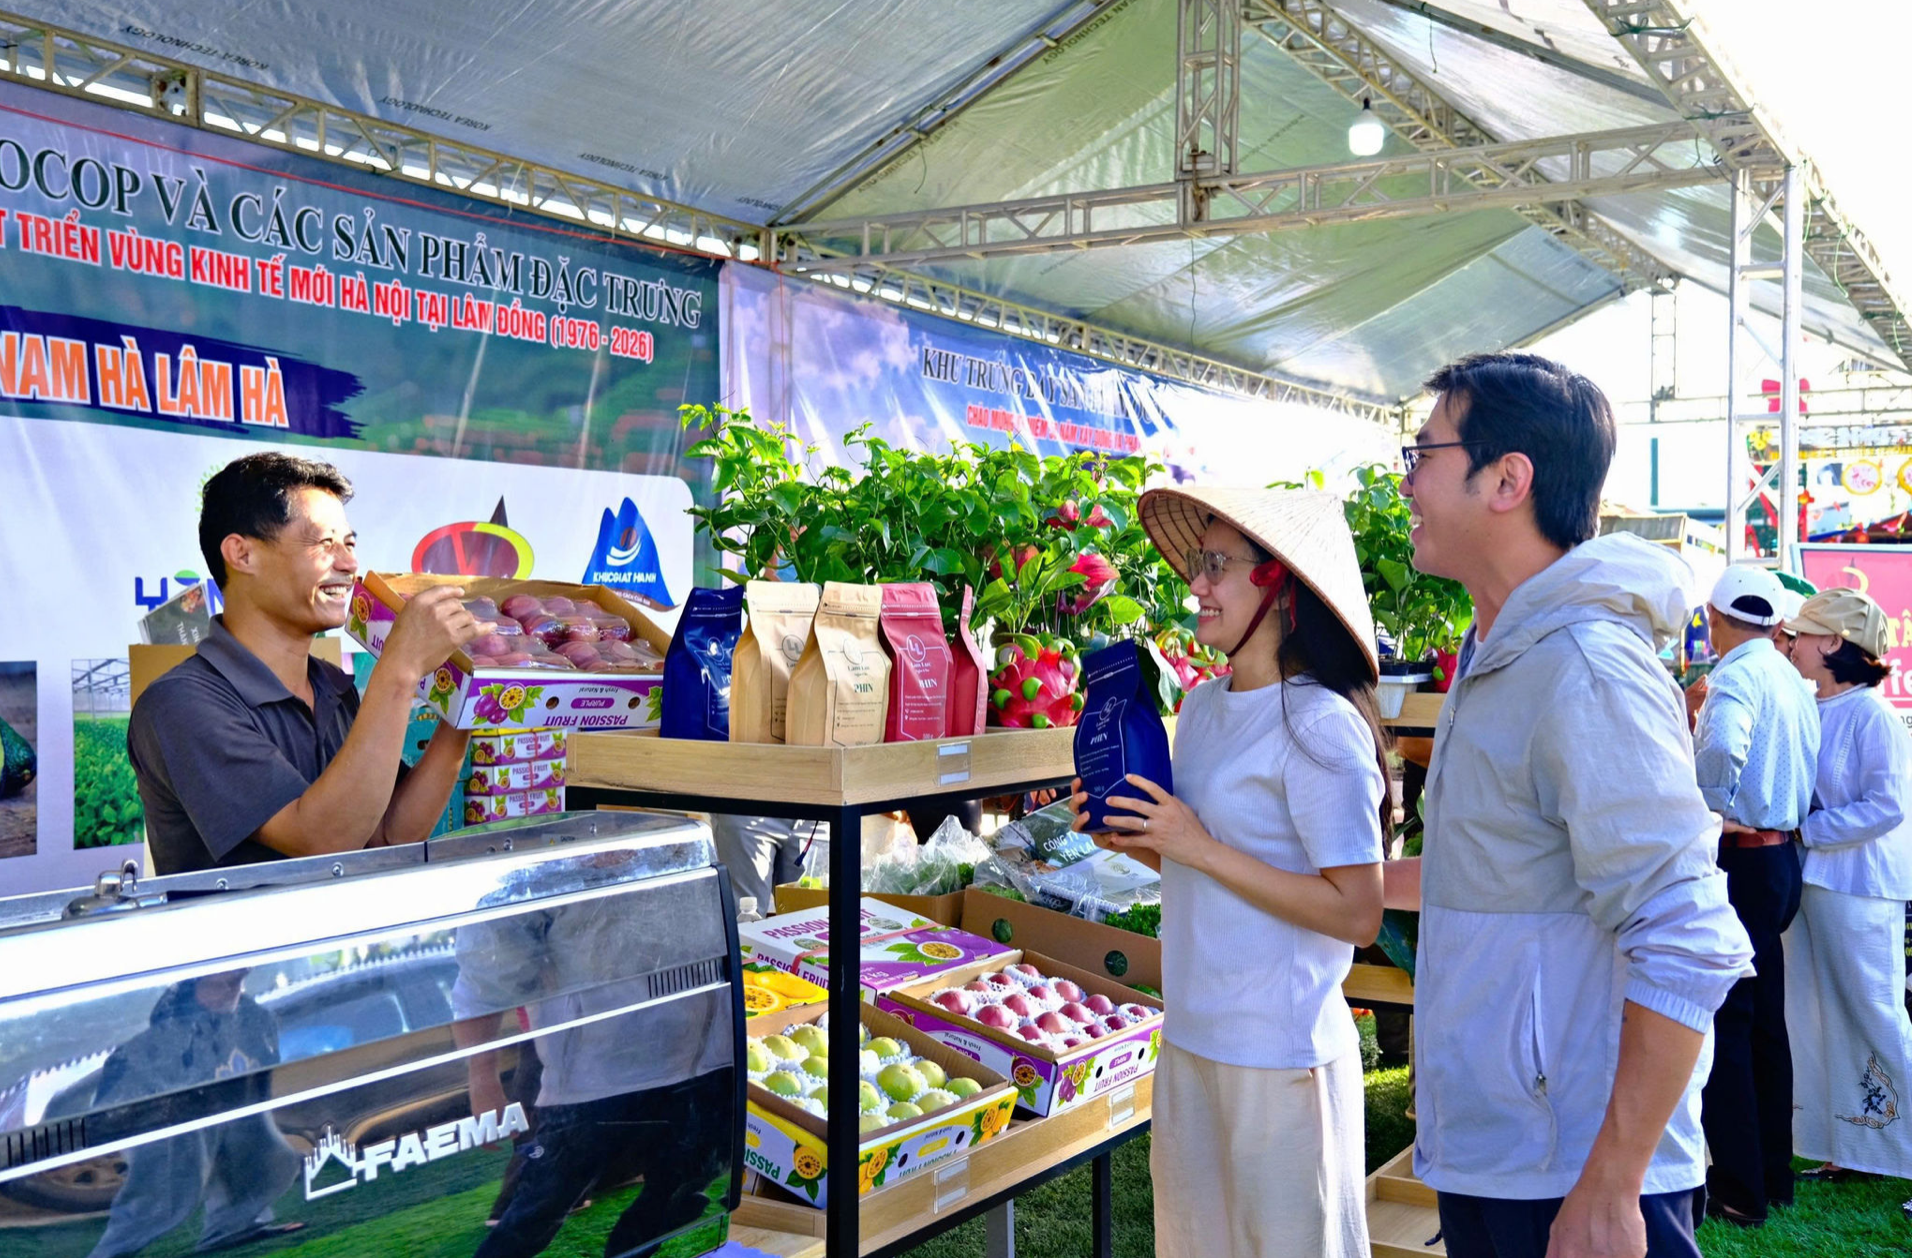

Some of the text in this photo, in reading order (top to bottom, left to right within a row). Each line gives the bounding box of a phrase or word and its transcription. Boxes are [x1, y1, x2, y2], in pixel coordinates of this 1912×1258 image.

[120, 26, 269, 71] KOREA TECHNOLOGY
[1042, 13, 1113, 65] TECHNOLOGY
[378, 96, 492, 132] KOREA TECHNOLOGY
[0, 138, 702, 328] OCOP VÀ CÁC SẢN PHẨM ĐẶC TRƯNG
[15, 209, 101, 267] TRIỂN
[108, 225, 184, 281] VÙNG
[190, 246, 251, 293] KINH
[256, 253, 284, 299] TẾ
[289, 263, 334, 309] MỚI
[340, 271, 369, 315] HÀ
[374, 280, 413, 326] NỘI
[416, 290, 448, 333] TẠI
[451, 293, 494, 334] LÂM
[496, 297, 546, 344] ĐỒNG
[550, 314, 600, 351] (1976
[610, 325, 654, 365] 2026)
[95, 335, 152, 413] HÀ
[155, 344, 235, 423] LÂM
[240, 356, 289, 428] HÀ
[543, 714, 629, 726] PASSION FRUIT
[580, 699, 606, 707] PURPLE
[517, 736, 536, 745] PASSIO
[762, 918, 829, 940] PASSION
[360, 1101, 530, 1182] FAEMA
